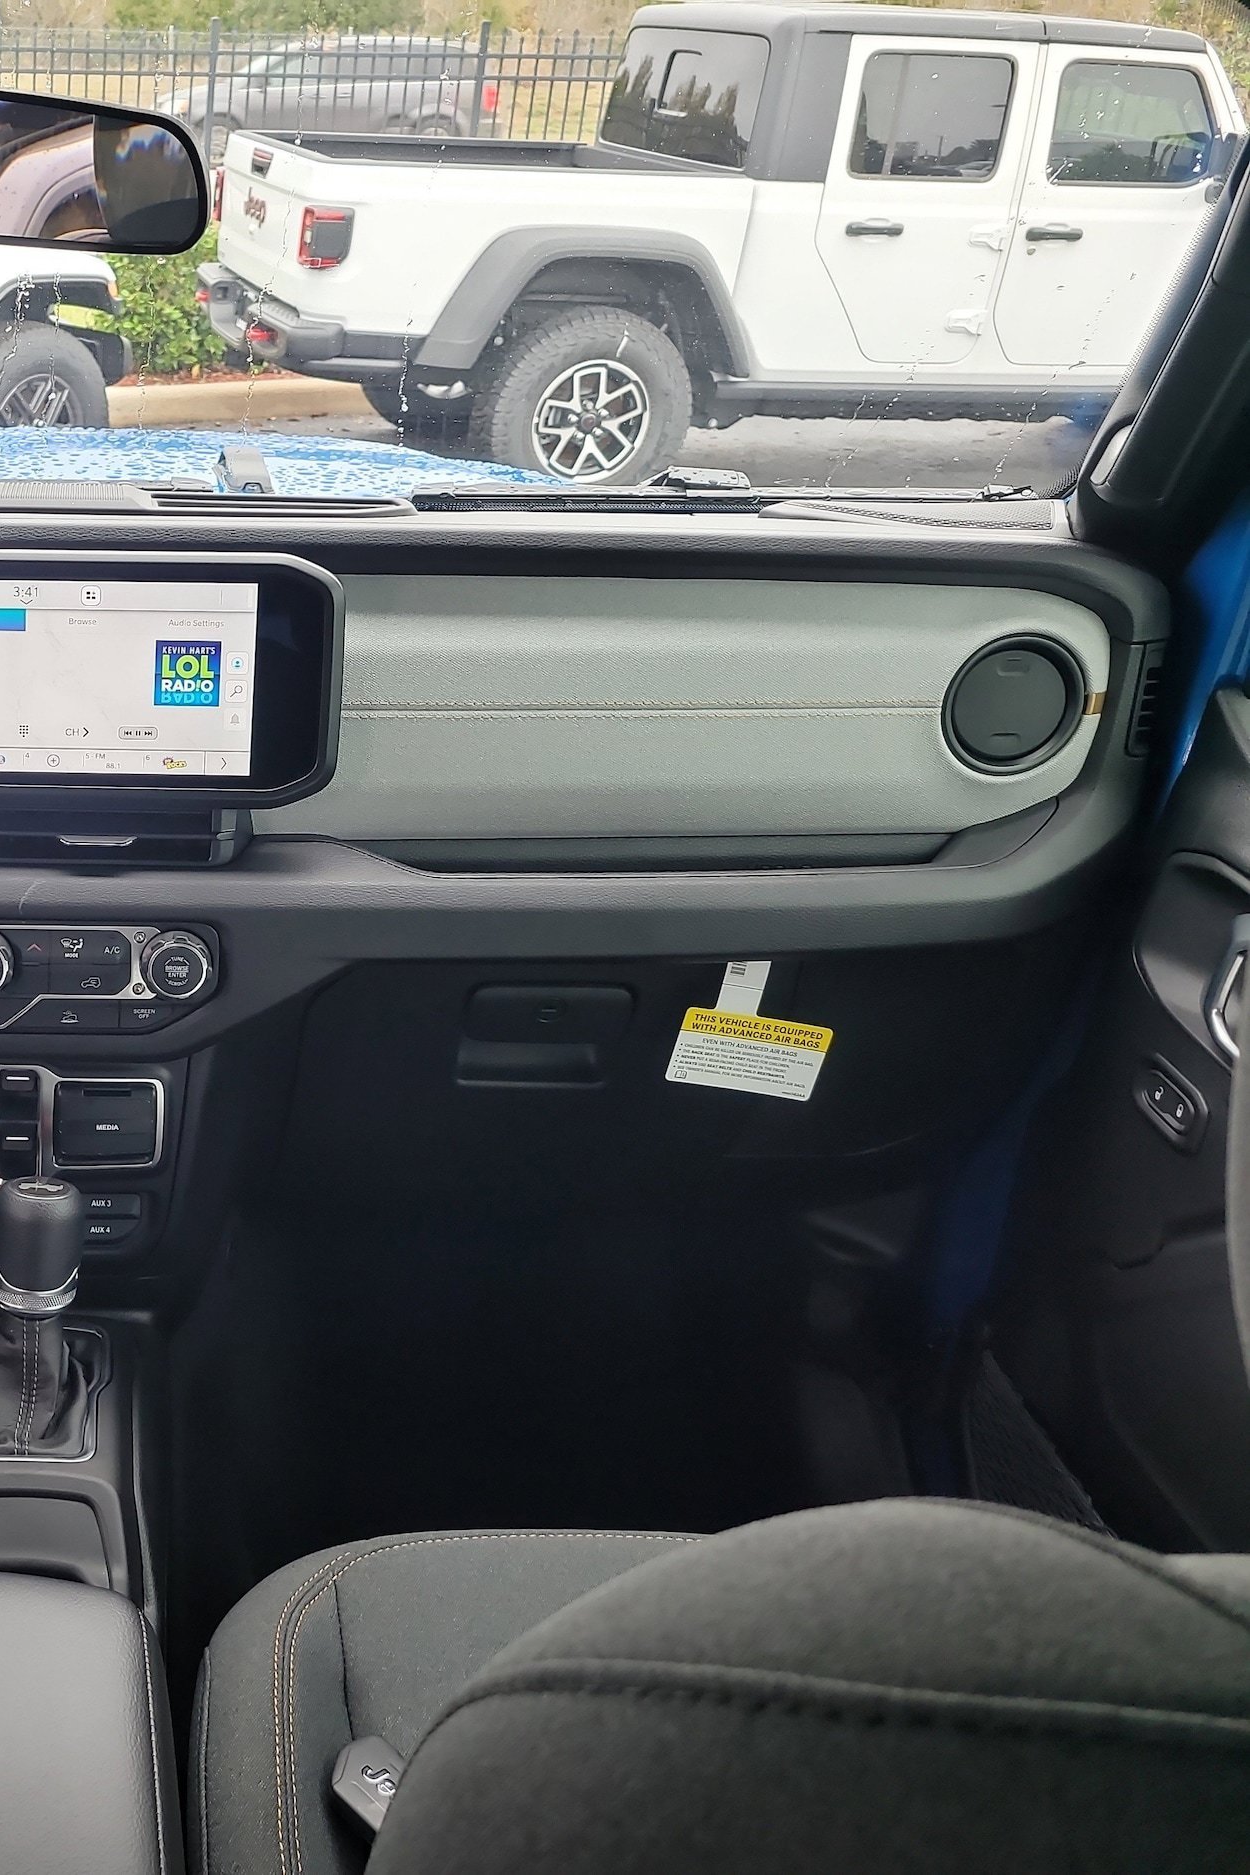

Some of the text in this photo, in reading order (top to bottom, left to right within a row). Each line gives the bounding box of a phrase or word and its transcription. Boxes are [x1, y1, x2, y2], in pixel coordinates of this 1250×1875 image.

[13, 586, 38, 597] 3:41
[168, 619, 224, 628] Audio Settings
[162, 646, 216, 655] KEVIN HART'S
[161, 655, 215, 679] LOL
[65, 728, 80, 736] CH
[104, 946, 120, 954] A/C
[694, 1013, 824, 1040] THIS VEHICLE IS EQUIPPED
[691, 1022, 821, 1049] WITH ADVANCED AIR BAGS
[702, 1038, 798, 1058] EVEN WITH ADVANCED AIR BAGS
[91, 1199, 112, 1207] AUX 3
